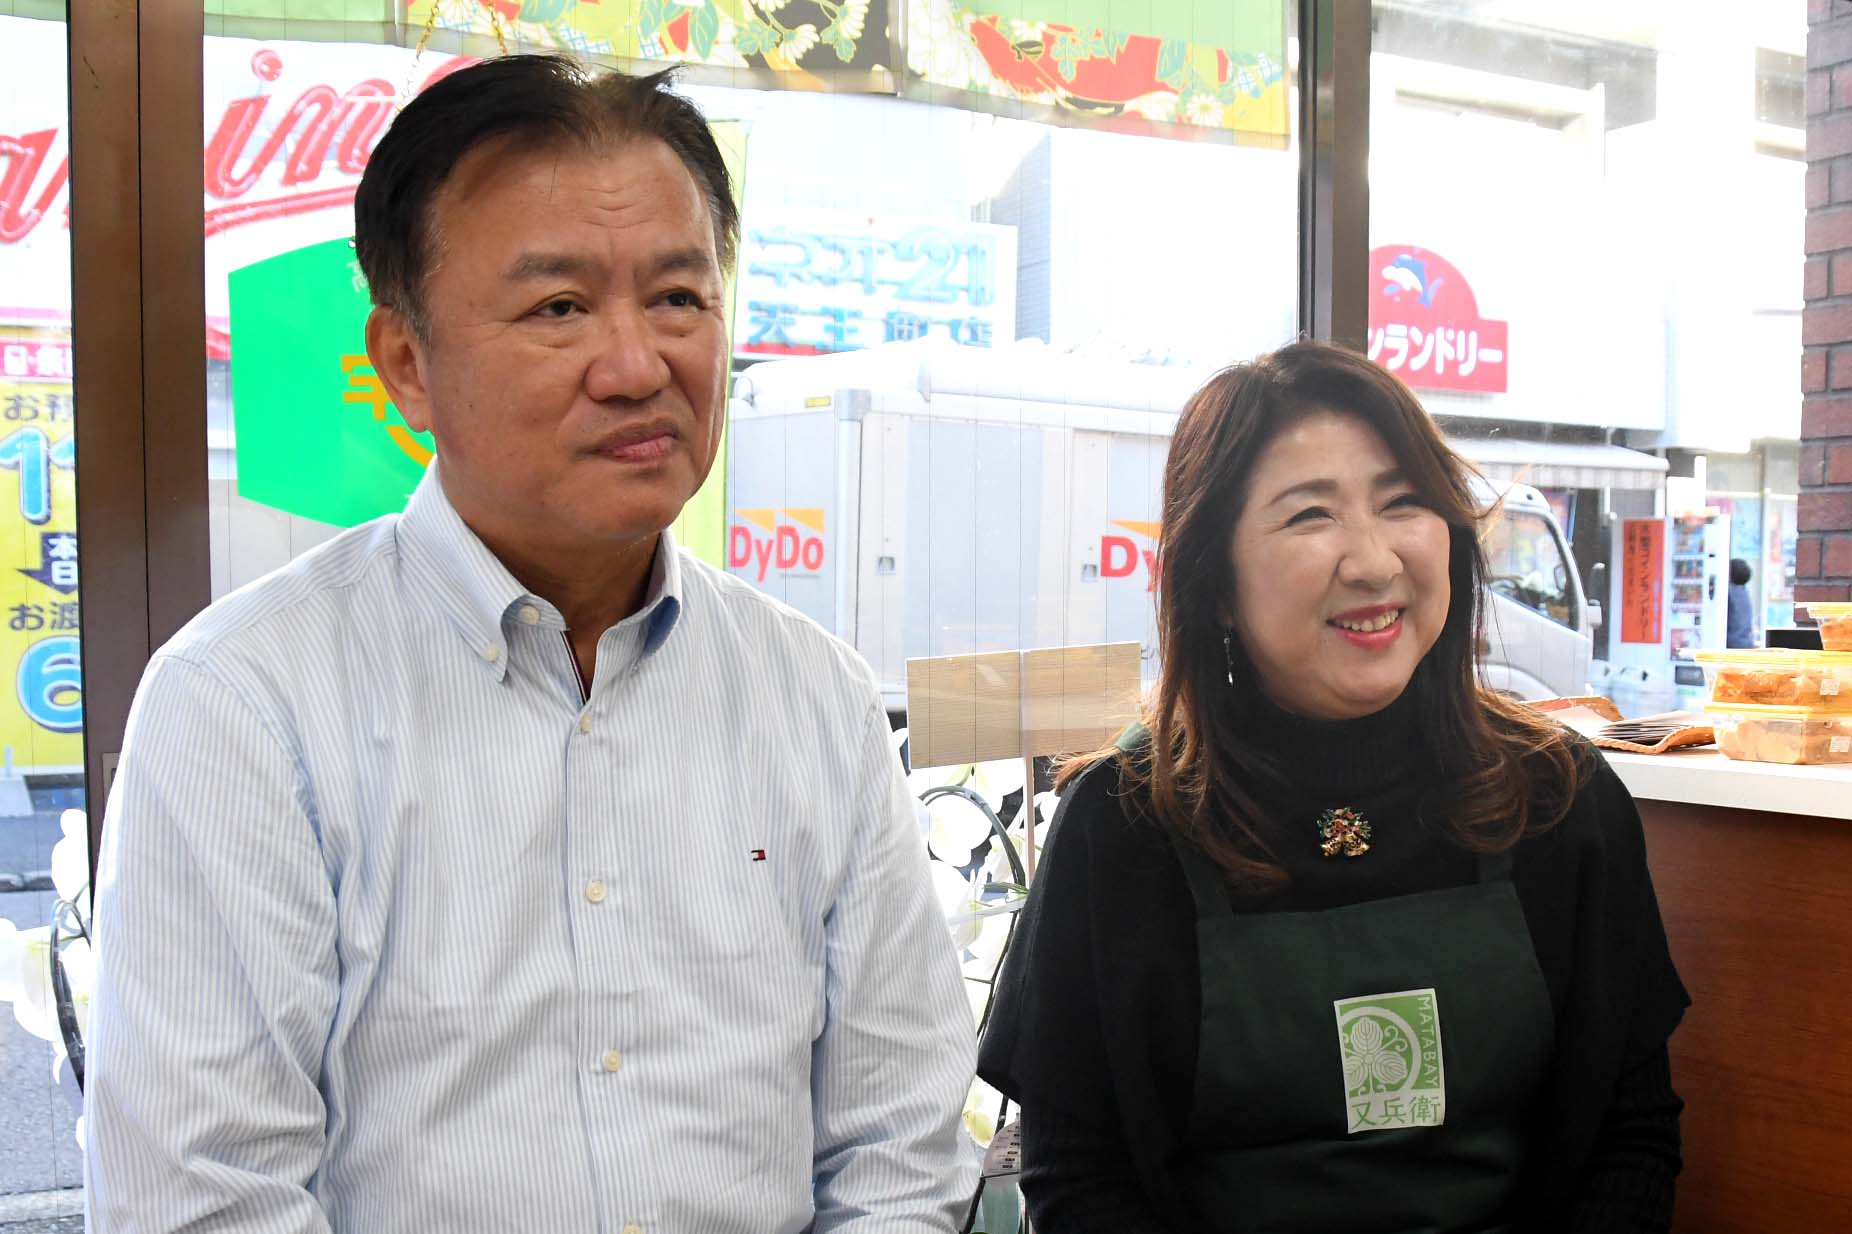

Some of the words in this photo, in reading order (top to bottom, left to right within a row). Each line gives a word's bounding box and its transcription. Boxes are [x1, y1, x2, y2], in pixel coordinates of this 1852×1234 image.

[729, 525, 824, 582] DyDo
[1417, 996, 1441, 1087] MATABAY
[1350, 1095, 1442, 1130] 又兵衛
